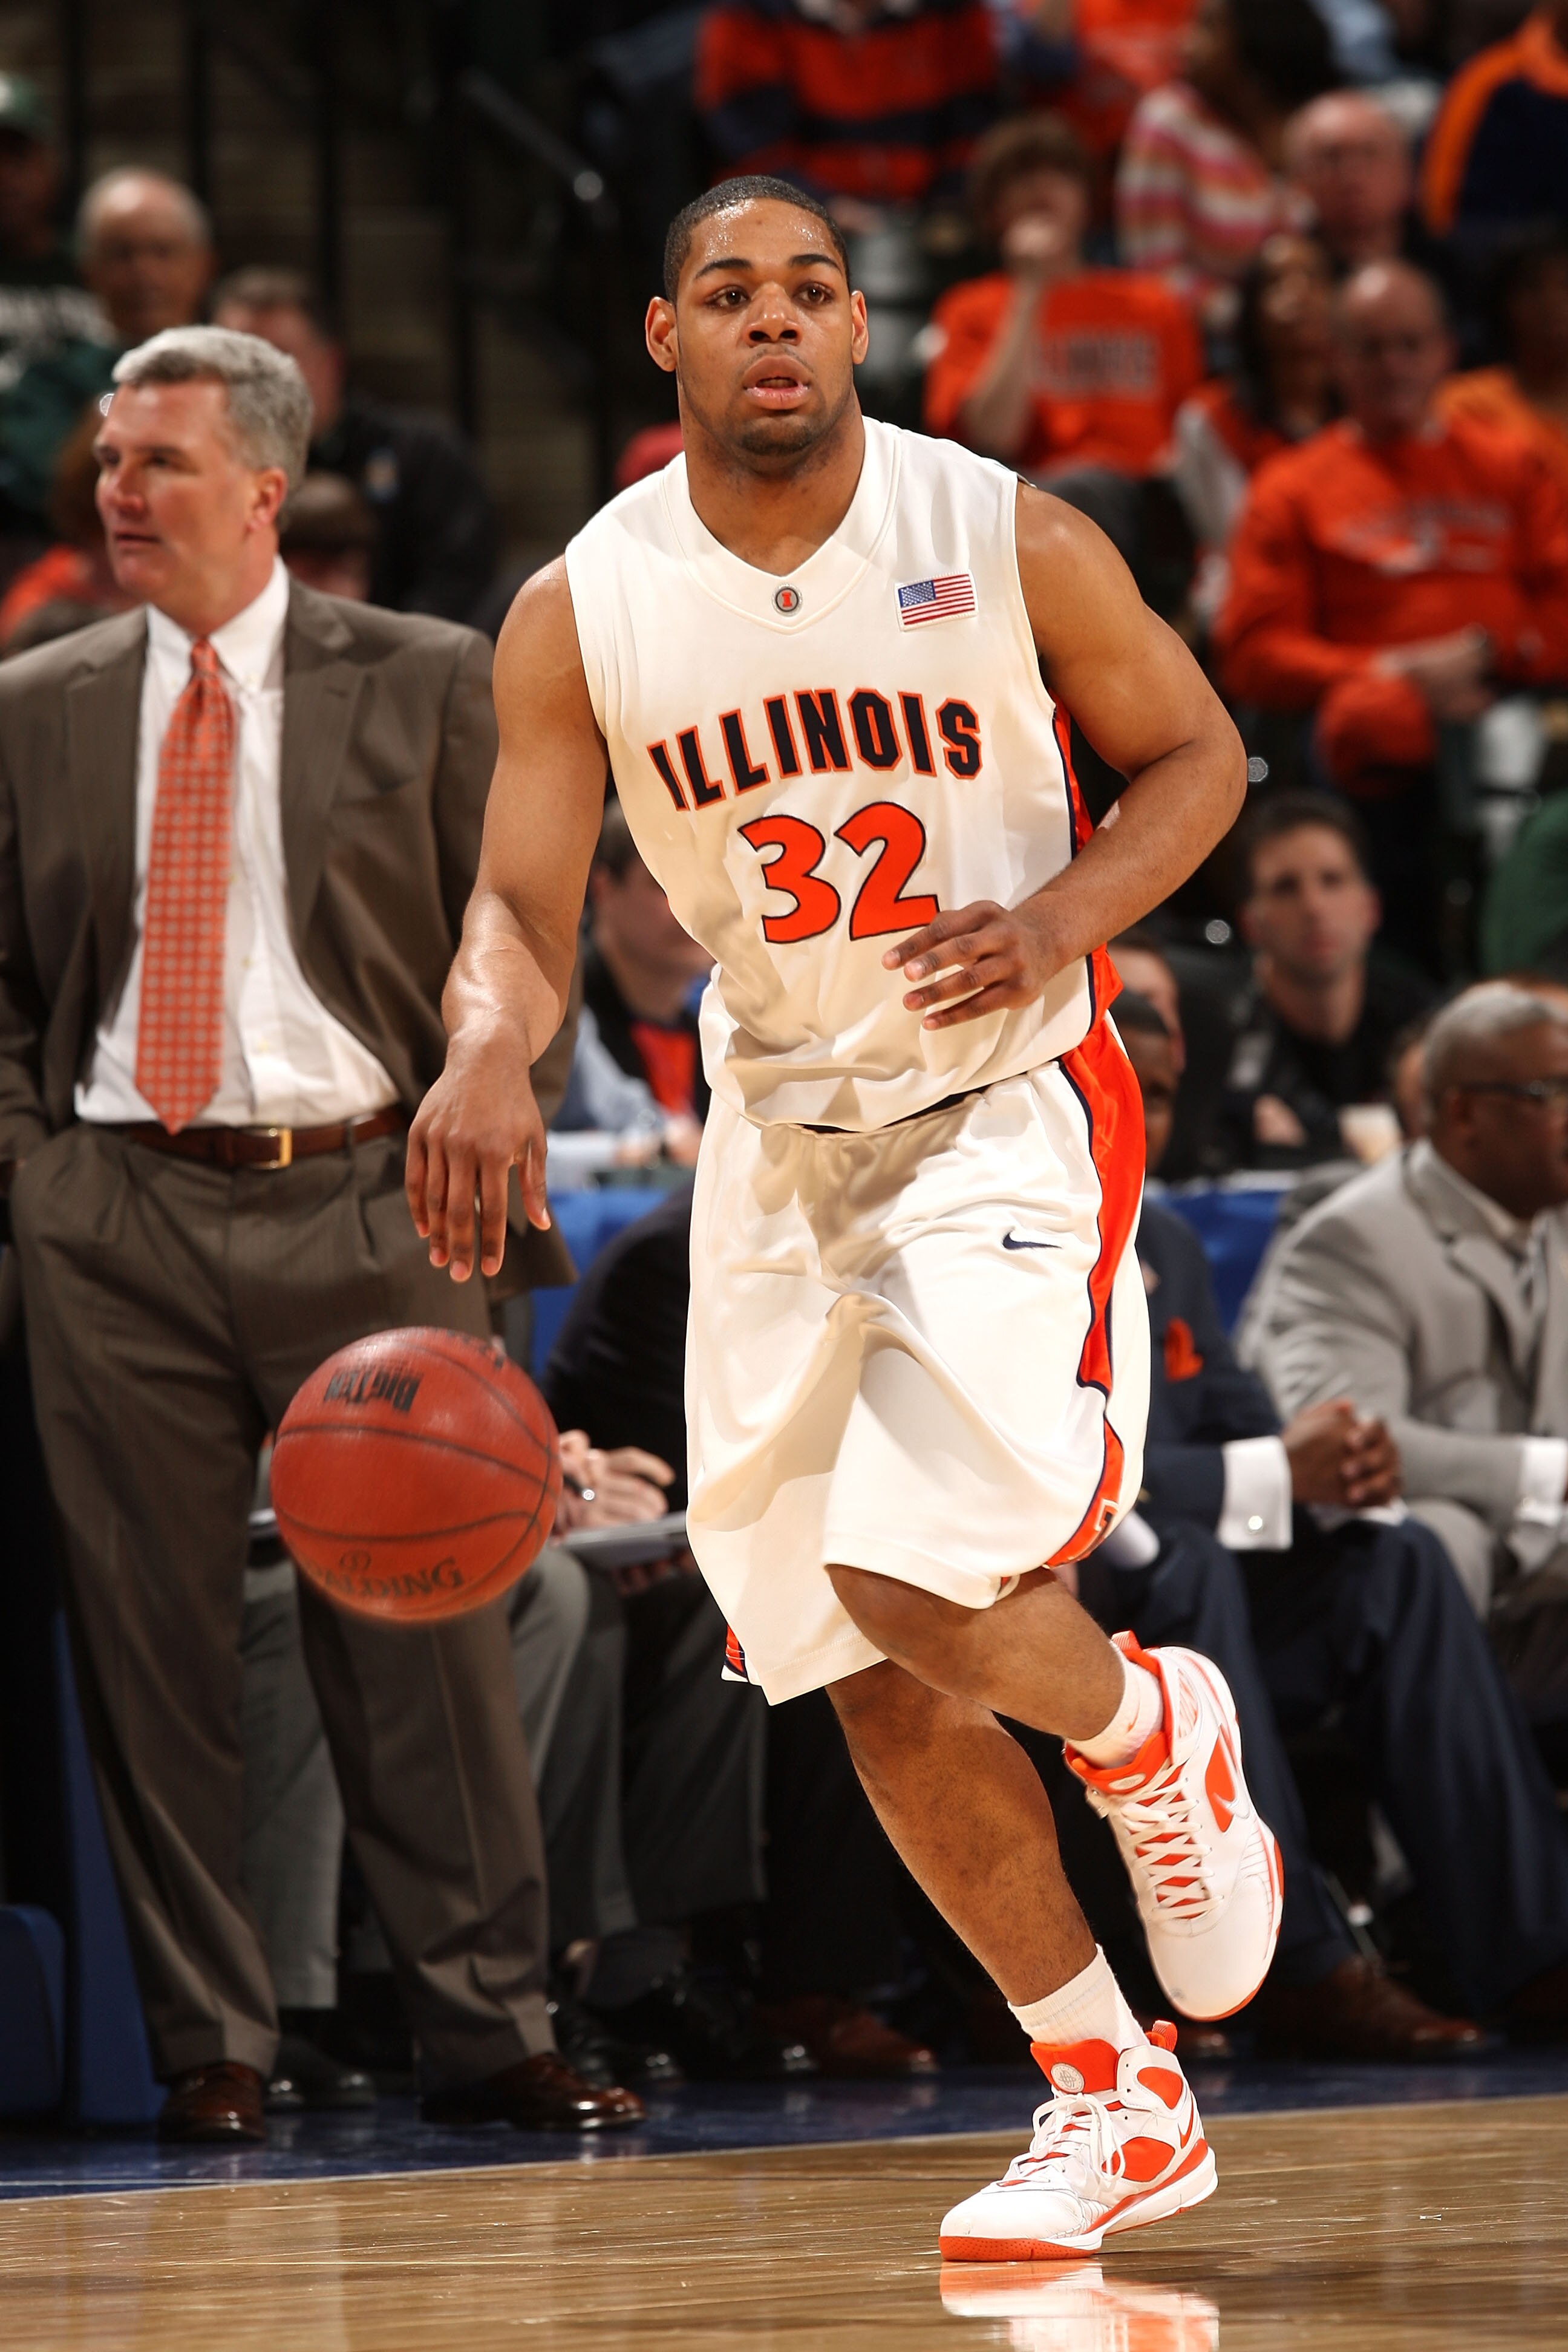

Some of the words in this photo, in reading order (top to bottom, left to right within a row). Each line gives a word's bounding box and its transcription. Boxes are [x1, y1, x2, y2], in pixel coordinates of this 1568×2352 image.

[647, 687, 983, 812] ILLINOIS
[737, 801, 940, 944] 32
[305, 1557, 465, 1598] ALDING
